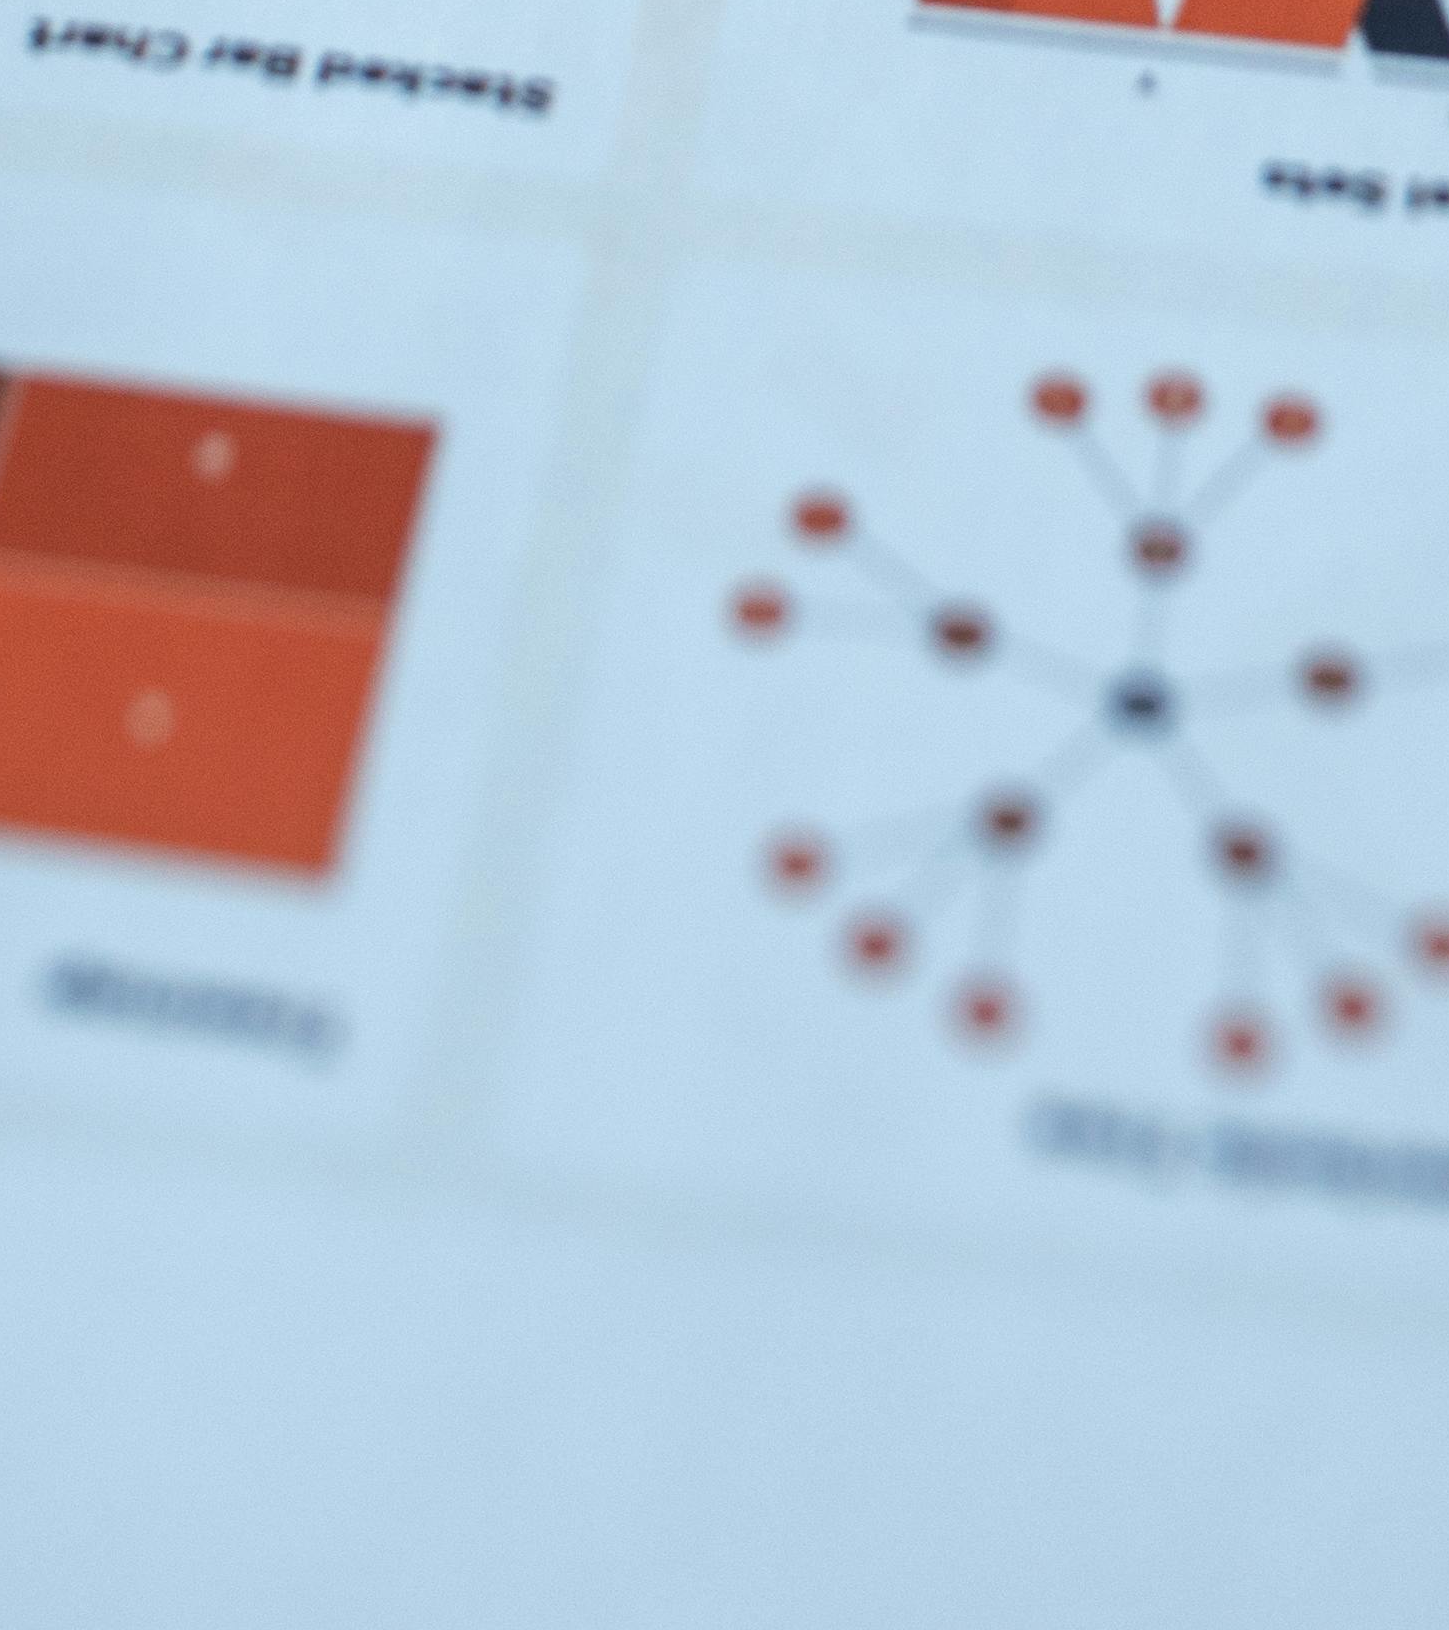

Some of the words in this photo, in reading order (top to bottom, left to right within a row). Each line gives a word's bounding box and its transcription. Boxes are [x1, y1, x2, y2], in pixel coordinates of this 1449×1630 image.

[30, 21, 188, 63] Chart
[207, 43, 300, 80] Bar
[316, 55, 551, 113] Stacked
[1263, 165, 1386, 209] Sets
